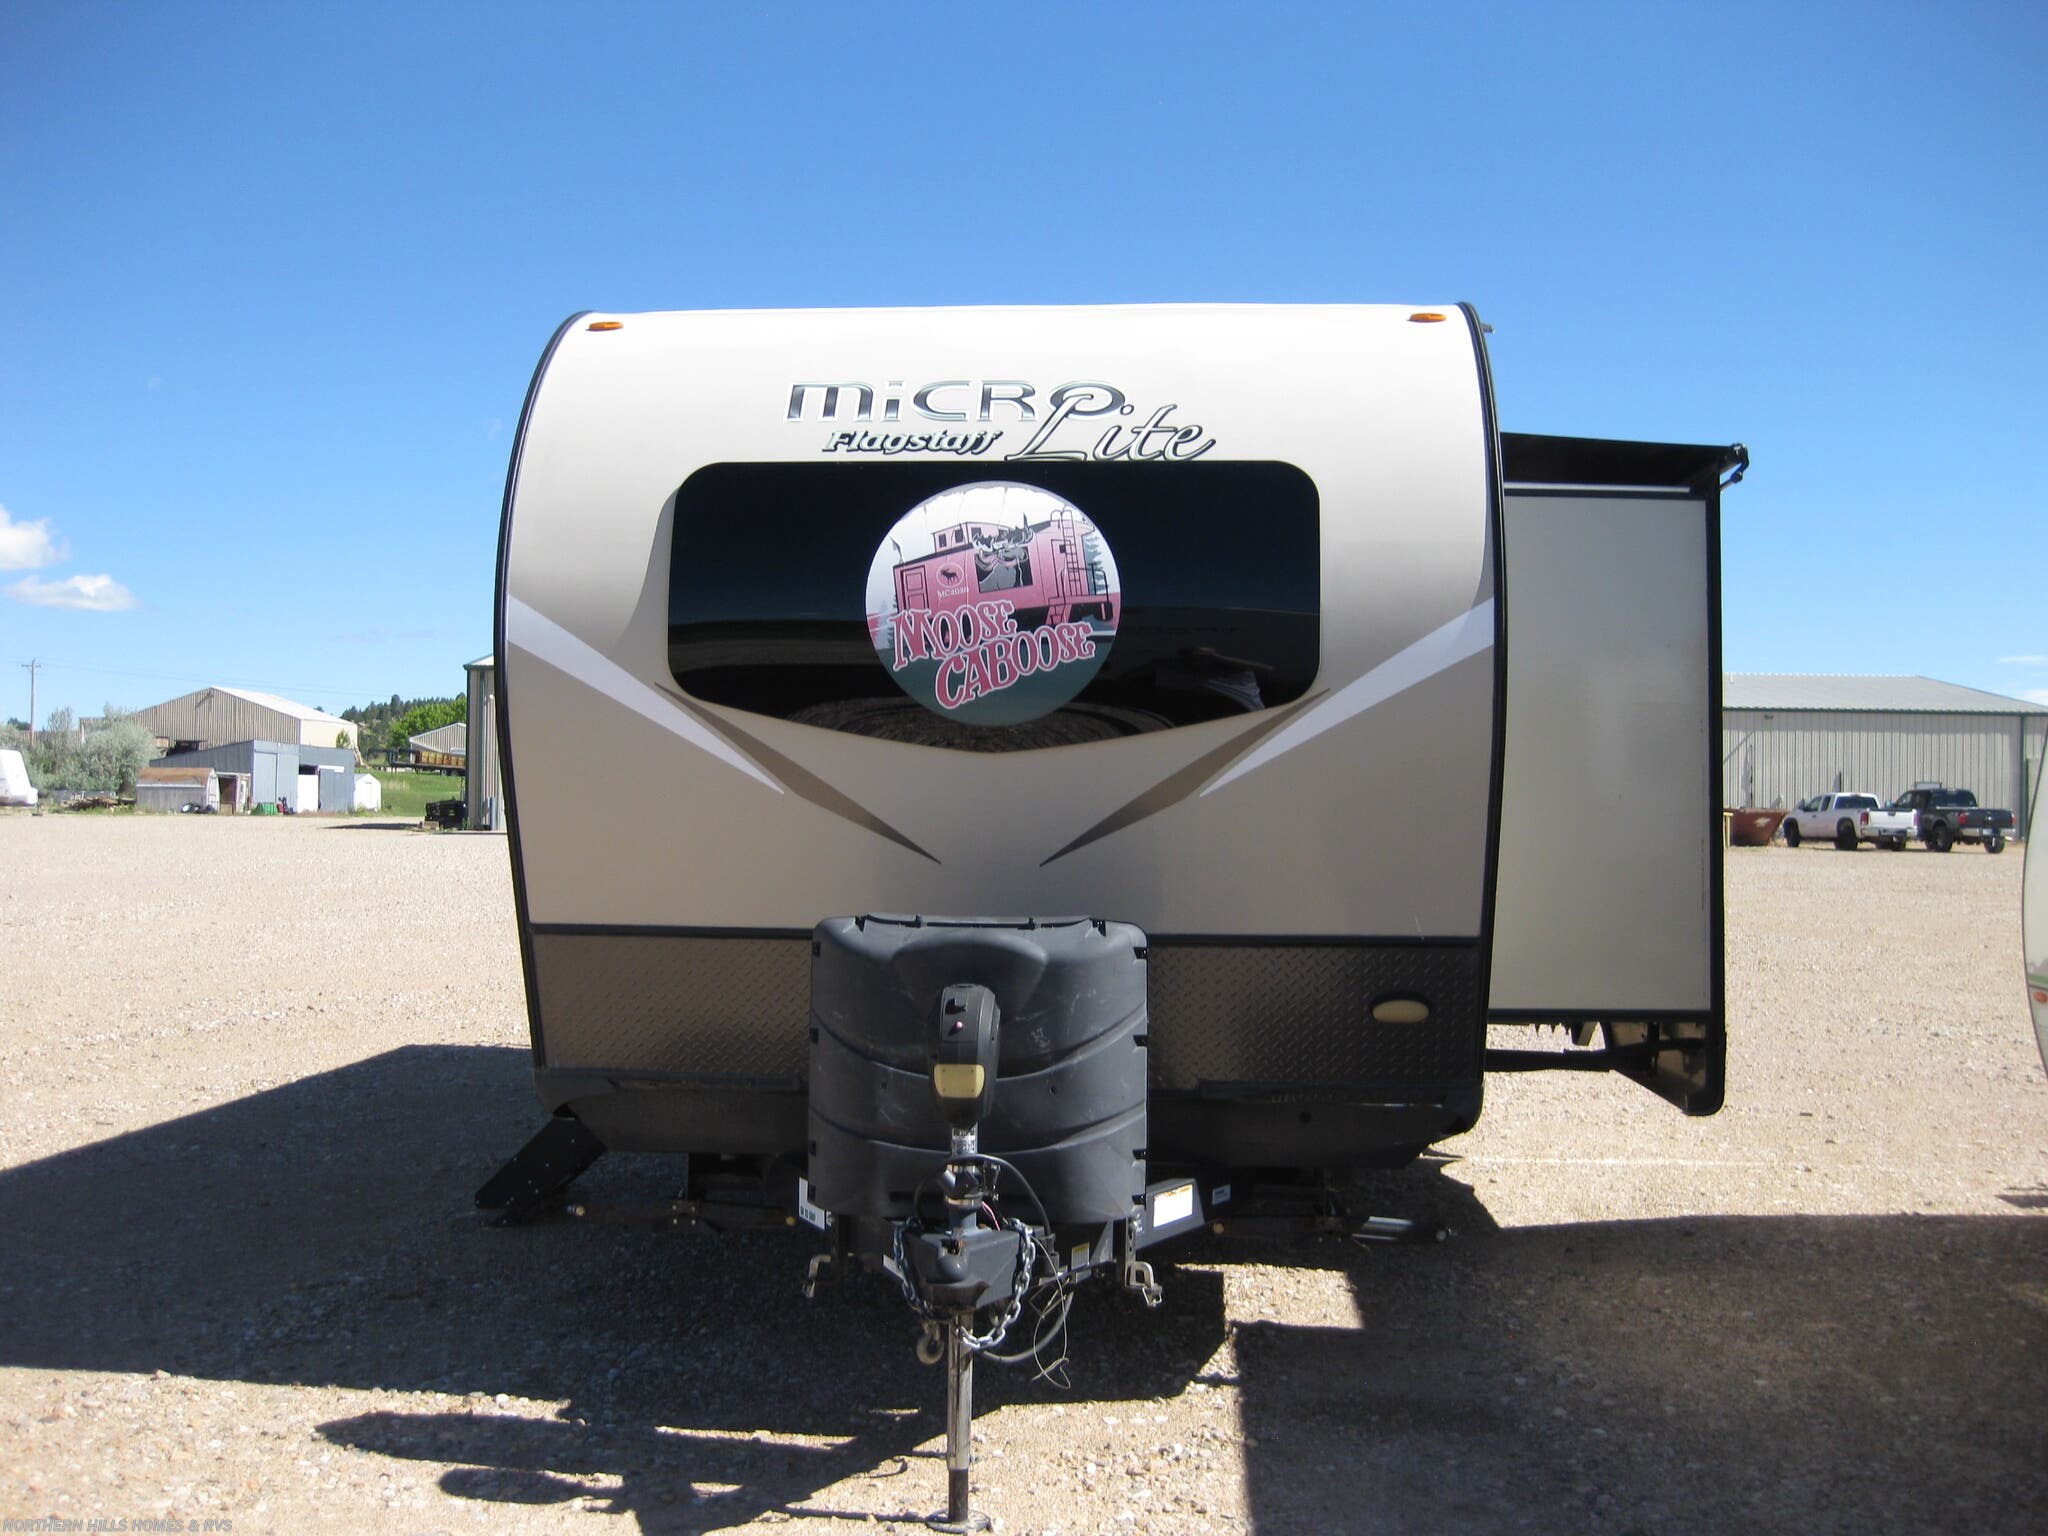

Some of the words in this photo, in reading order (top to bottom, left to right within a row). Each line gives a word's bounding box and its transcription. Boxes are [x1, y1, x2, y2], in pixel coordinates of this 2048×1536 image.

[822, 428, 1005, 454] Flagstaff
[1004, 392, 1217, 462] Lite
[889, 599, 1019, 671] MOOSE
[934, 621, 1096, 710] CABOOSE
